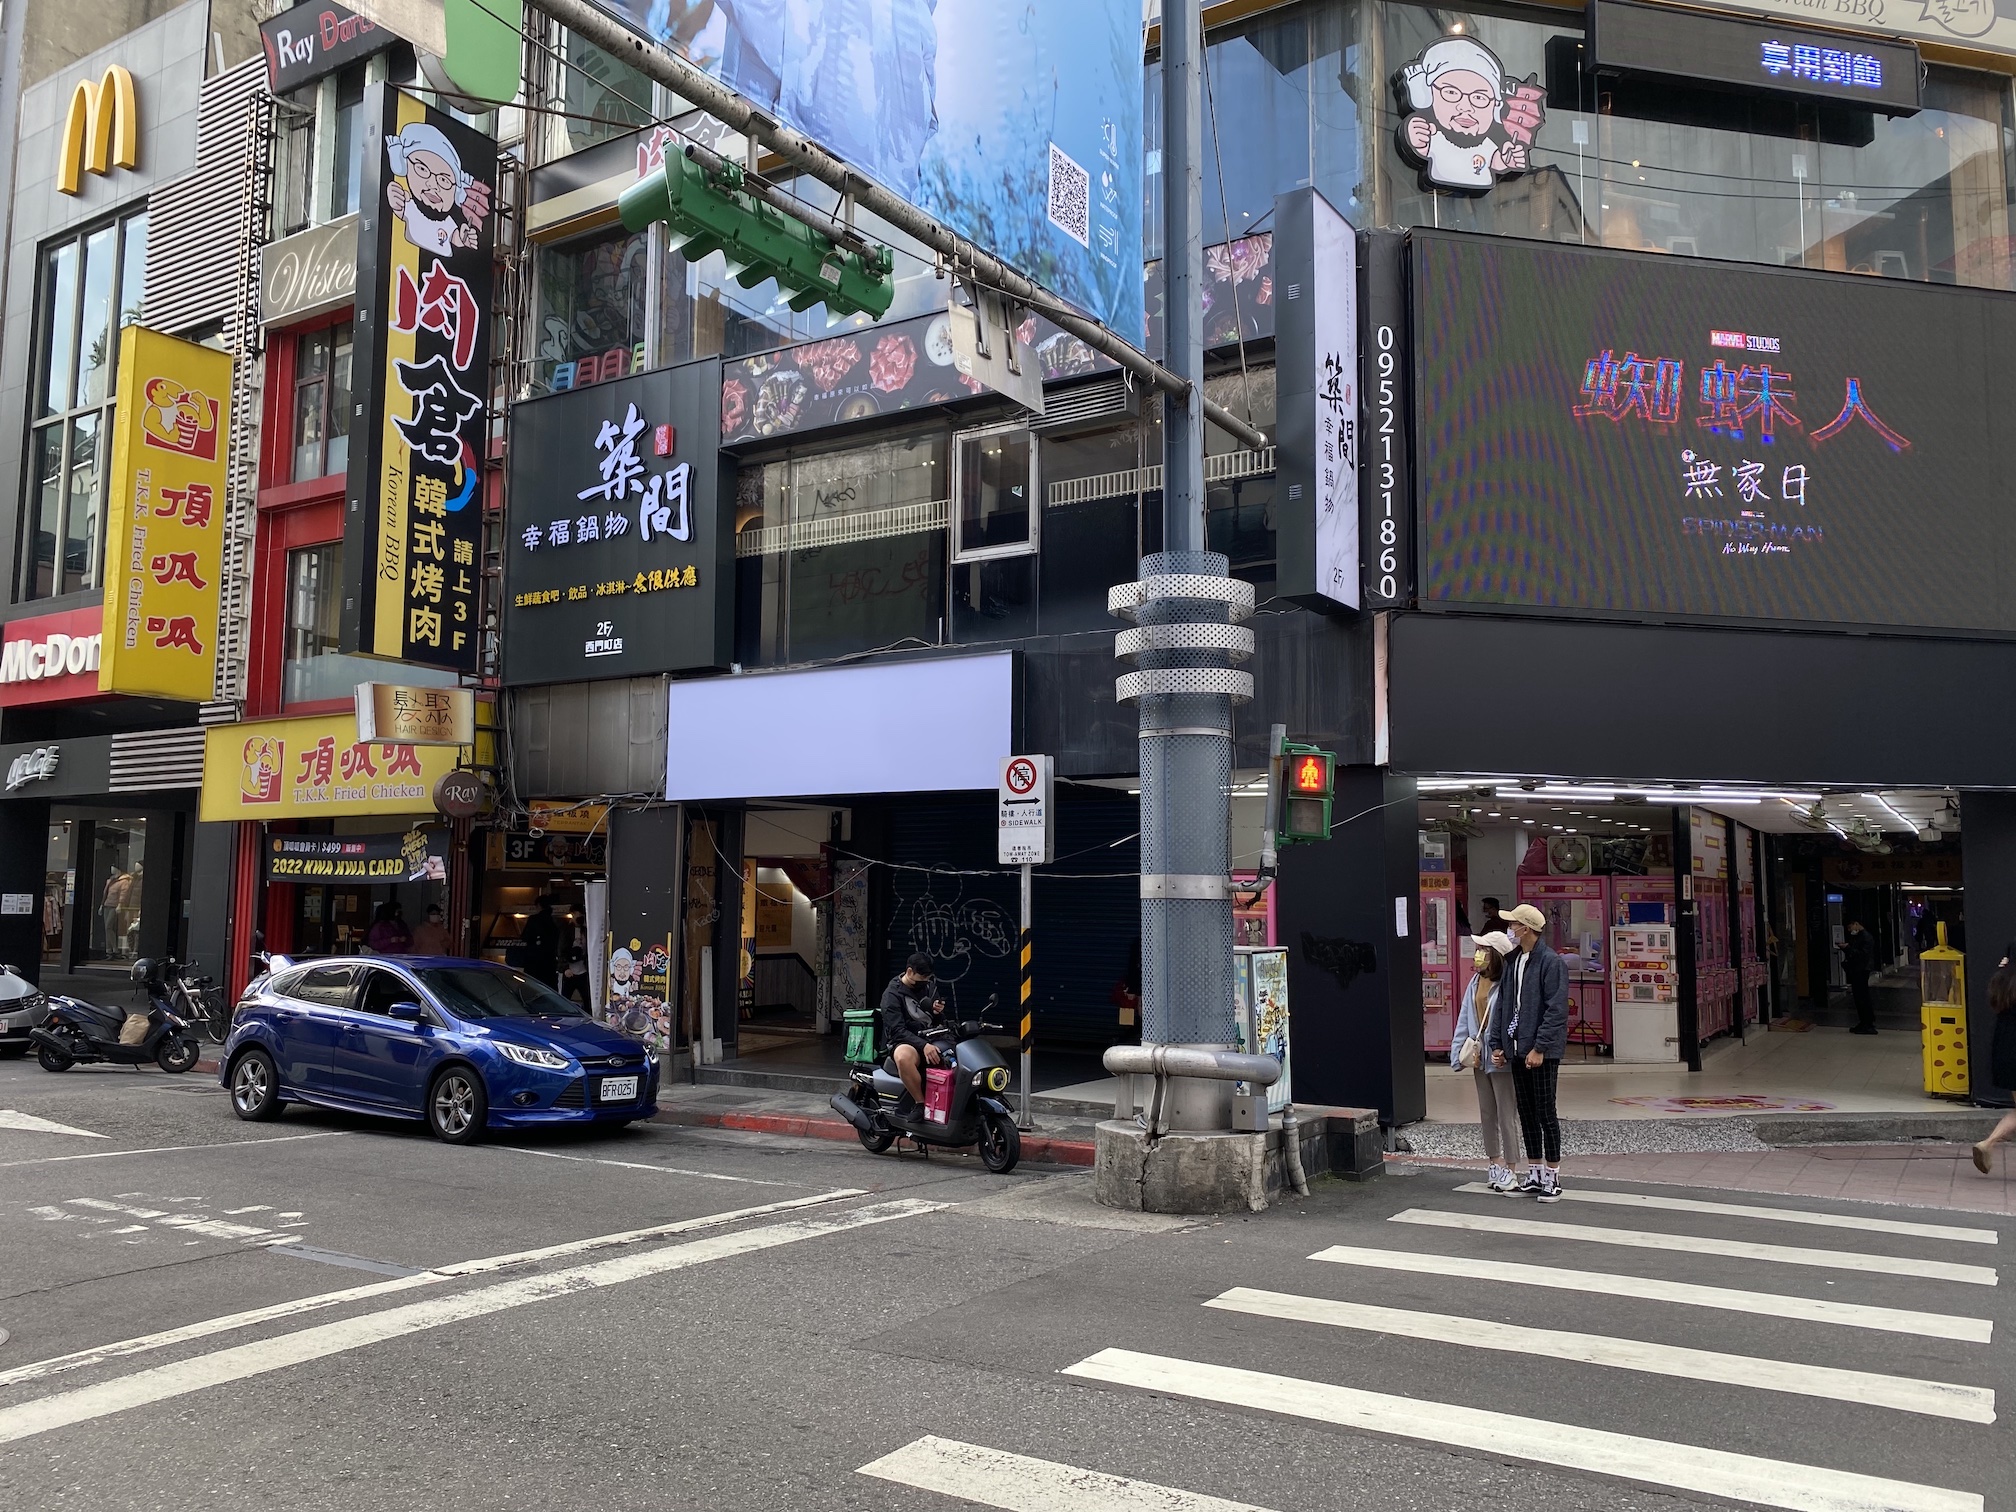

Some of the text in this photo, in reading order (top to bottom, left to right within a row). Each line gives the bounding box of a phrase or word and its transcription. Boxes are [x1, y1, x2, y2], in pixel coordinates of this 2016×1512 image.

[1833, 0, 1887, 25] BBQ
[277, 29, 314, 69] Ray
[1710, 332, 1780, 350] MARVEL STUDIOS
[1573, 349, 1911, 448] 蜘蛛人
[577, 402, 690, 542] 築間
[1324, 416, 1335, 515] 幸福鍋物
[1377, 325, 1398, 600] 0952131860
[1683, 459, 1810, 506] 無家日
[379, 464, 403, 581] Korean BBQ
[521, 511, 629, 552] 幸福鍋物
[125, 468, 151, 649] T.K.K. Fried Chicken
[410, 474, 448, 647] 韓式烤肉
[1722, 542, 1737, 554] No
[147, 482, 213, 656] 頂呱呱
[585, 638, 623, 653] 西門町店
[394, 724, 453, 737] HAIR DESIGN
[296, 736, 422, 786] 頂呱呱
[1012, 766, 1030, 786] 停
[294, 783, 424, 803] T.K.K. Fried Chicken
[444, 784, 478, 804] Ray
[272, 858, 303, 874] 2022
[303, 859, 334, 875] KWA
[369, 858, 404, 876] CARD
[322, 842, 341, 854] $499
[511, 840, 535, 859] 3F
